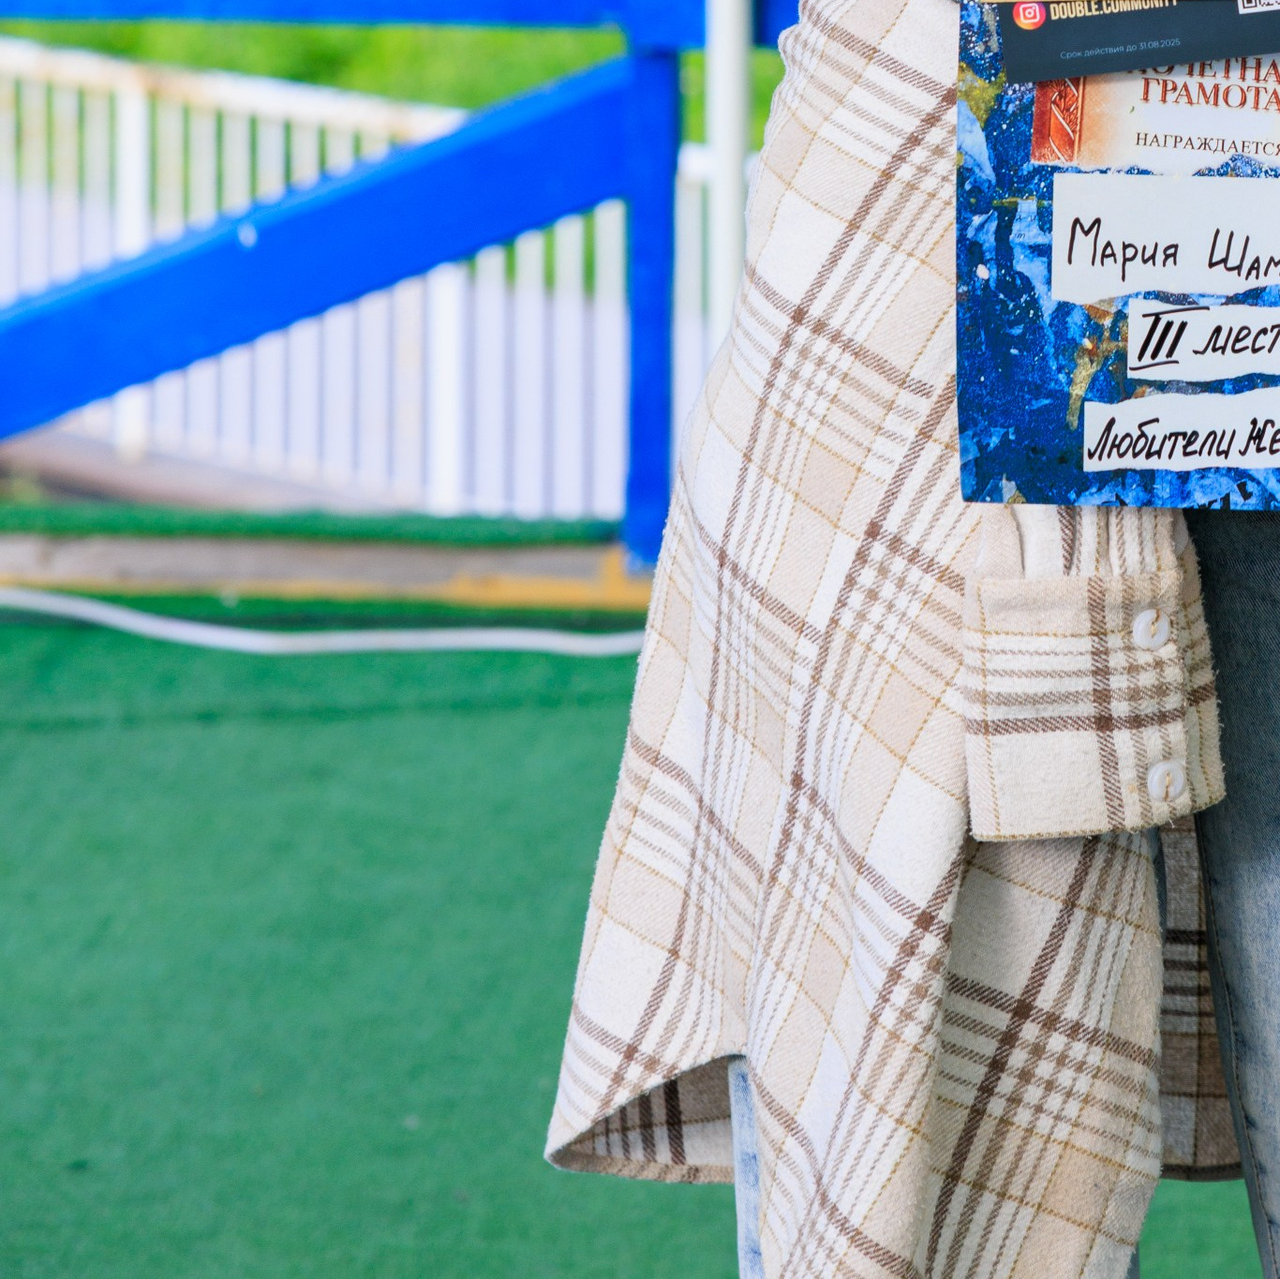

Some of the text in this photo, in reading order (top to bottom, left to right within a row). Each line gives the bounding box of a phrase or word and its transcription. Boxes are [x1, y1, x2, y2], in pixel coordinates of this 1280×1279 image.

[1060, 38, 1181, 60] Срок действия до 31.08.2025
[1067, 217, 1180, 282] Мария
[1086, 416, 1237, 462] Любители
